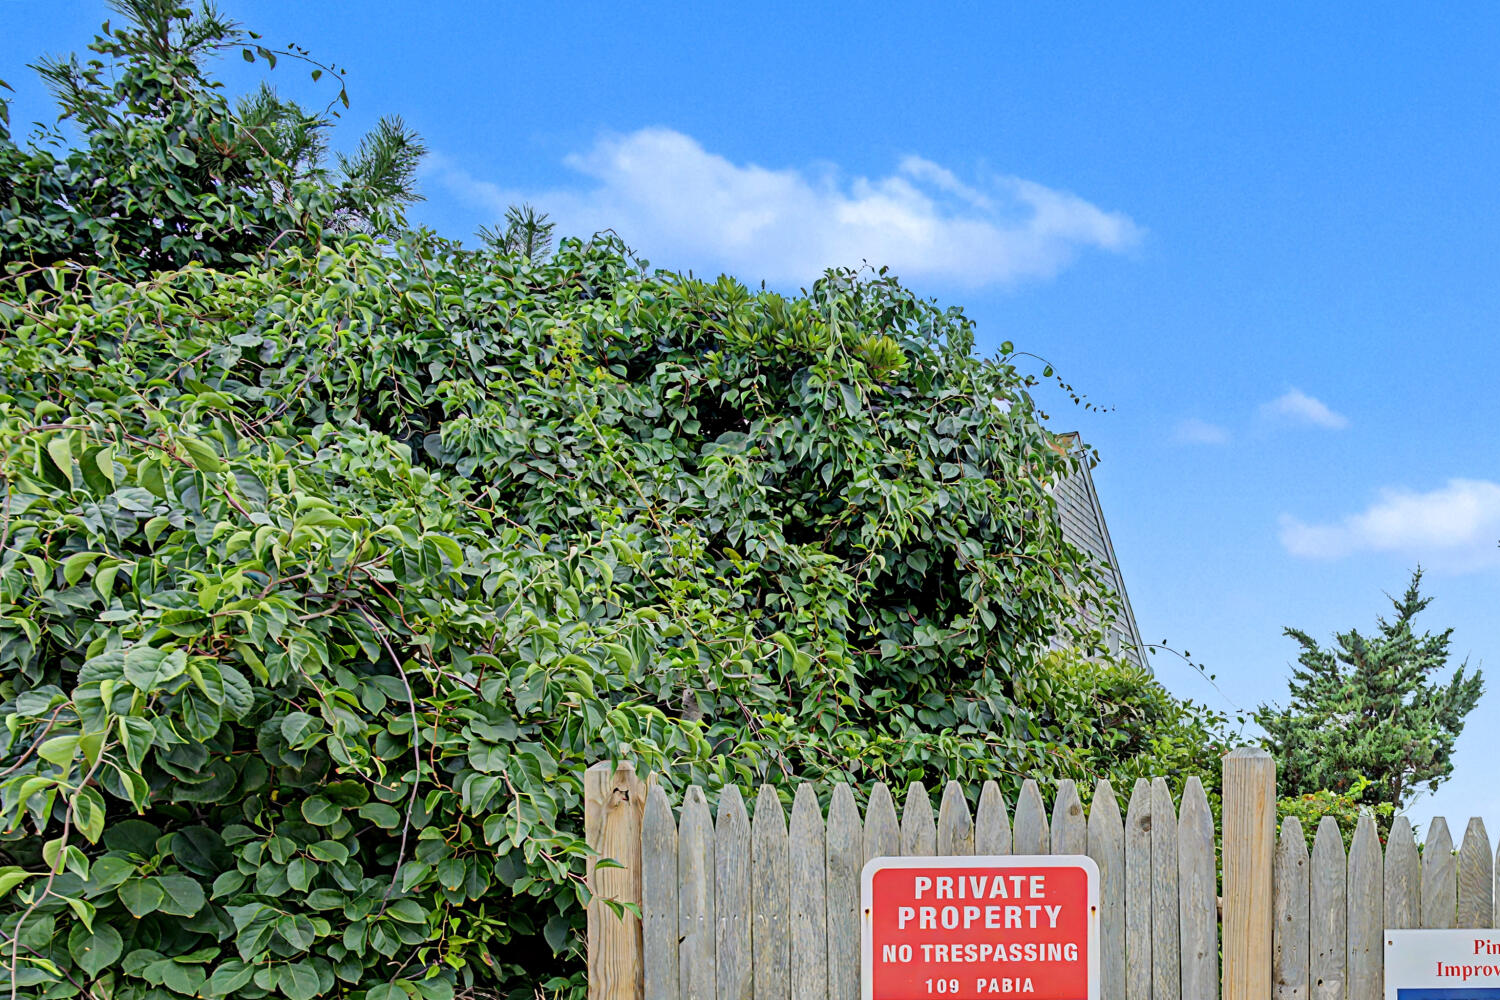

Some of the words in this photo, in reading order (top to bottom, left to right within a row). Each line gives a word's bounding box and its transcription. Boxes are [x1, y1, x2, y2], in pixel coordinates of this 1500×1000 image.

[914, 875, 1046, 900] PRIVATE
[898, 904, 1062, 930] PROPERTY
[882, 944, 913, 963] NO
[920, 942, 1078, 963] TRESPASSING
[925, 978, 960, 994] 109
[976, 977, 1035, 993] PABIA
